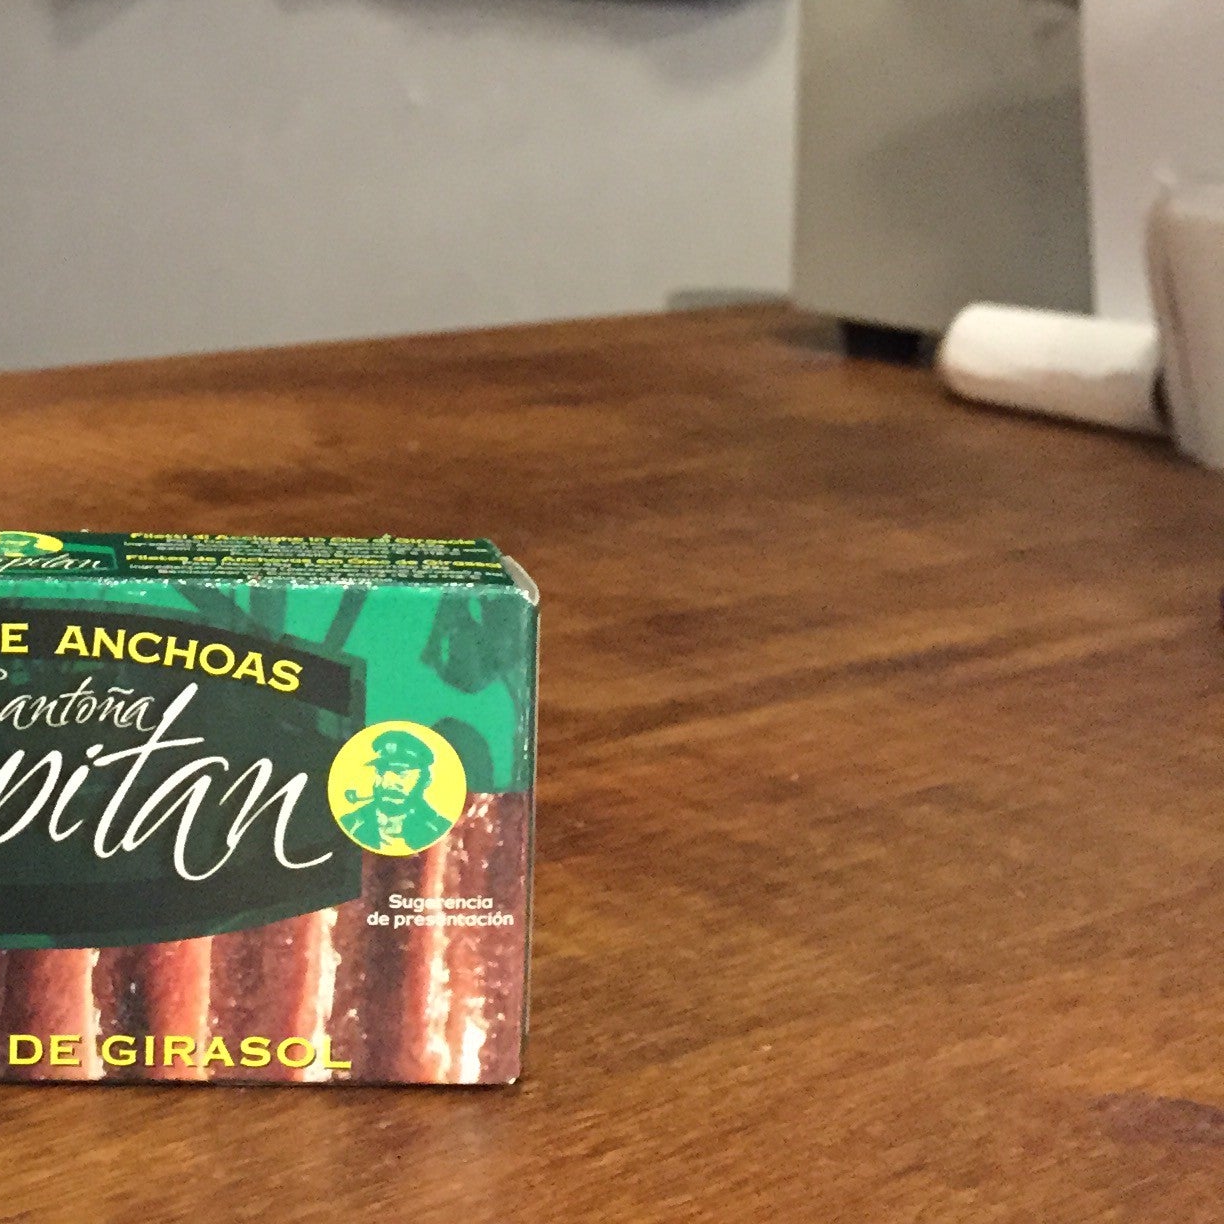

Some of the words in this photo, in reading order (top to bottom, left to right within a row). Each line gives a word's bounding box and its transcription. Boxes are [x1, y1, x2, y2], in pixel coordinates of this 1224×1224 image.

[56, 625, 303, 693] ANCHOAS
[388, 893, 494, 912] Sugerencia
[366, 911, 390, 926] de
[393, 911, 515, 929] presentación
[9, 1033, 82, 1067] DE
[101, 1034, 353, 1071] GIRASOL
